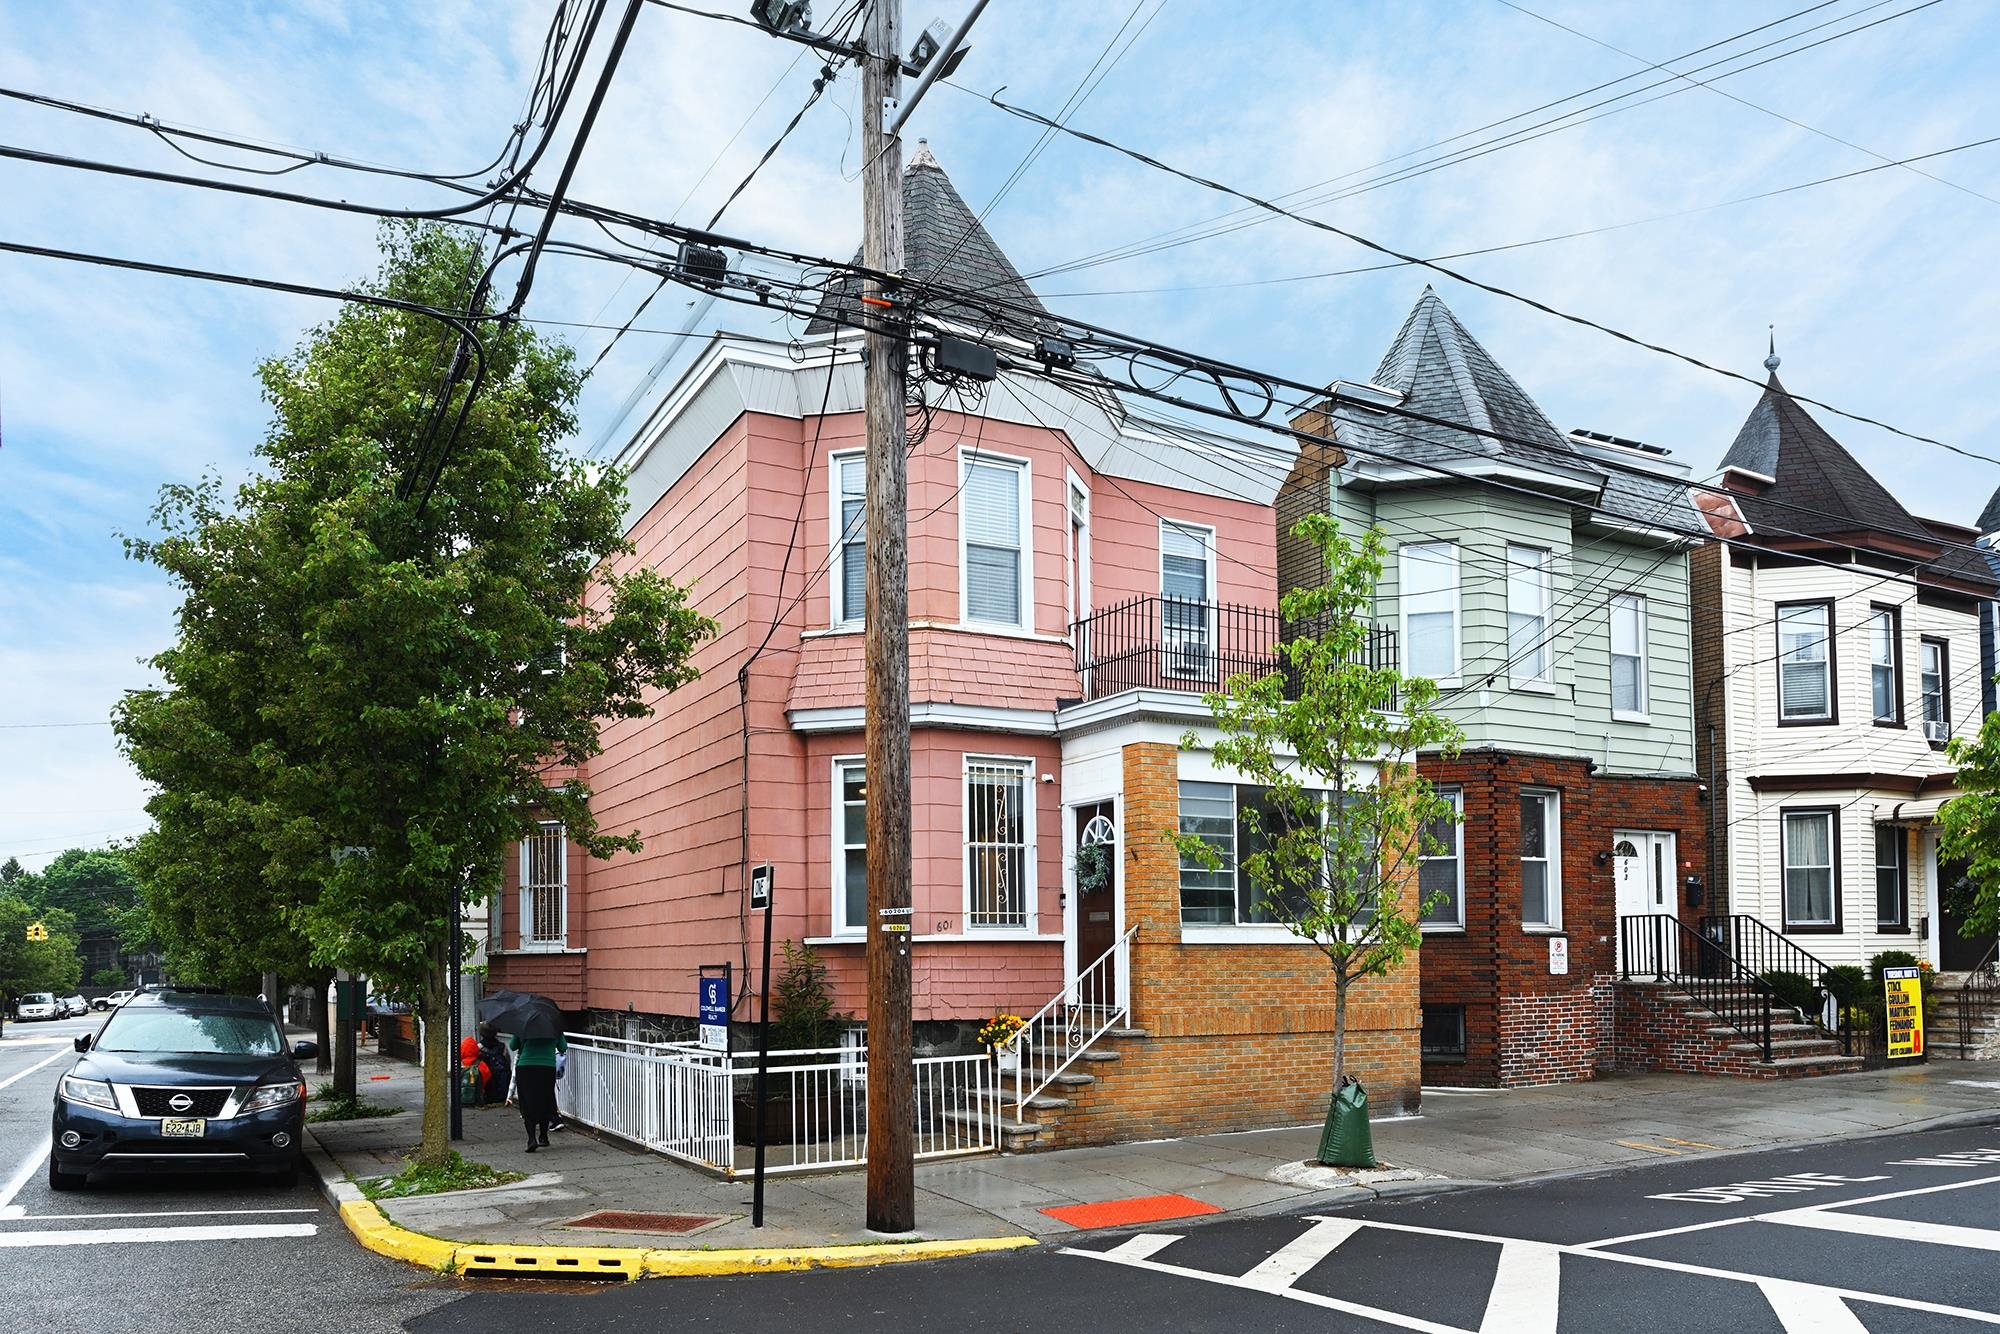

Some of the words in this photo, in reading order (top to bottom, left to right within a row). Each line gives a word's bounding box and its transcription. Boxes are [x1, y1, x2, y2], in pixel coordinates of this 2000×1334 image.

[936, 920, 953, 932] 601
[1887, 981, 1902, 992] STACK
[1889, 993, 1910, 1005] GRULLON
[1889, 1006, 1917, 1018] MARTINETTI
[1890, 1019, 1916, 1031] FERNANDEZ
[1890, 1048, 1899, 1056] VOTE
[1899, 1047, 1913, 1055] COLUMN
[1643, 1172, 1893, 1204] DRIVE
